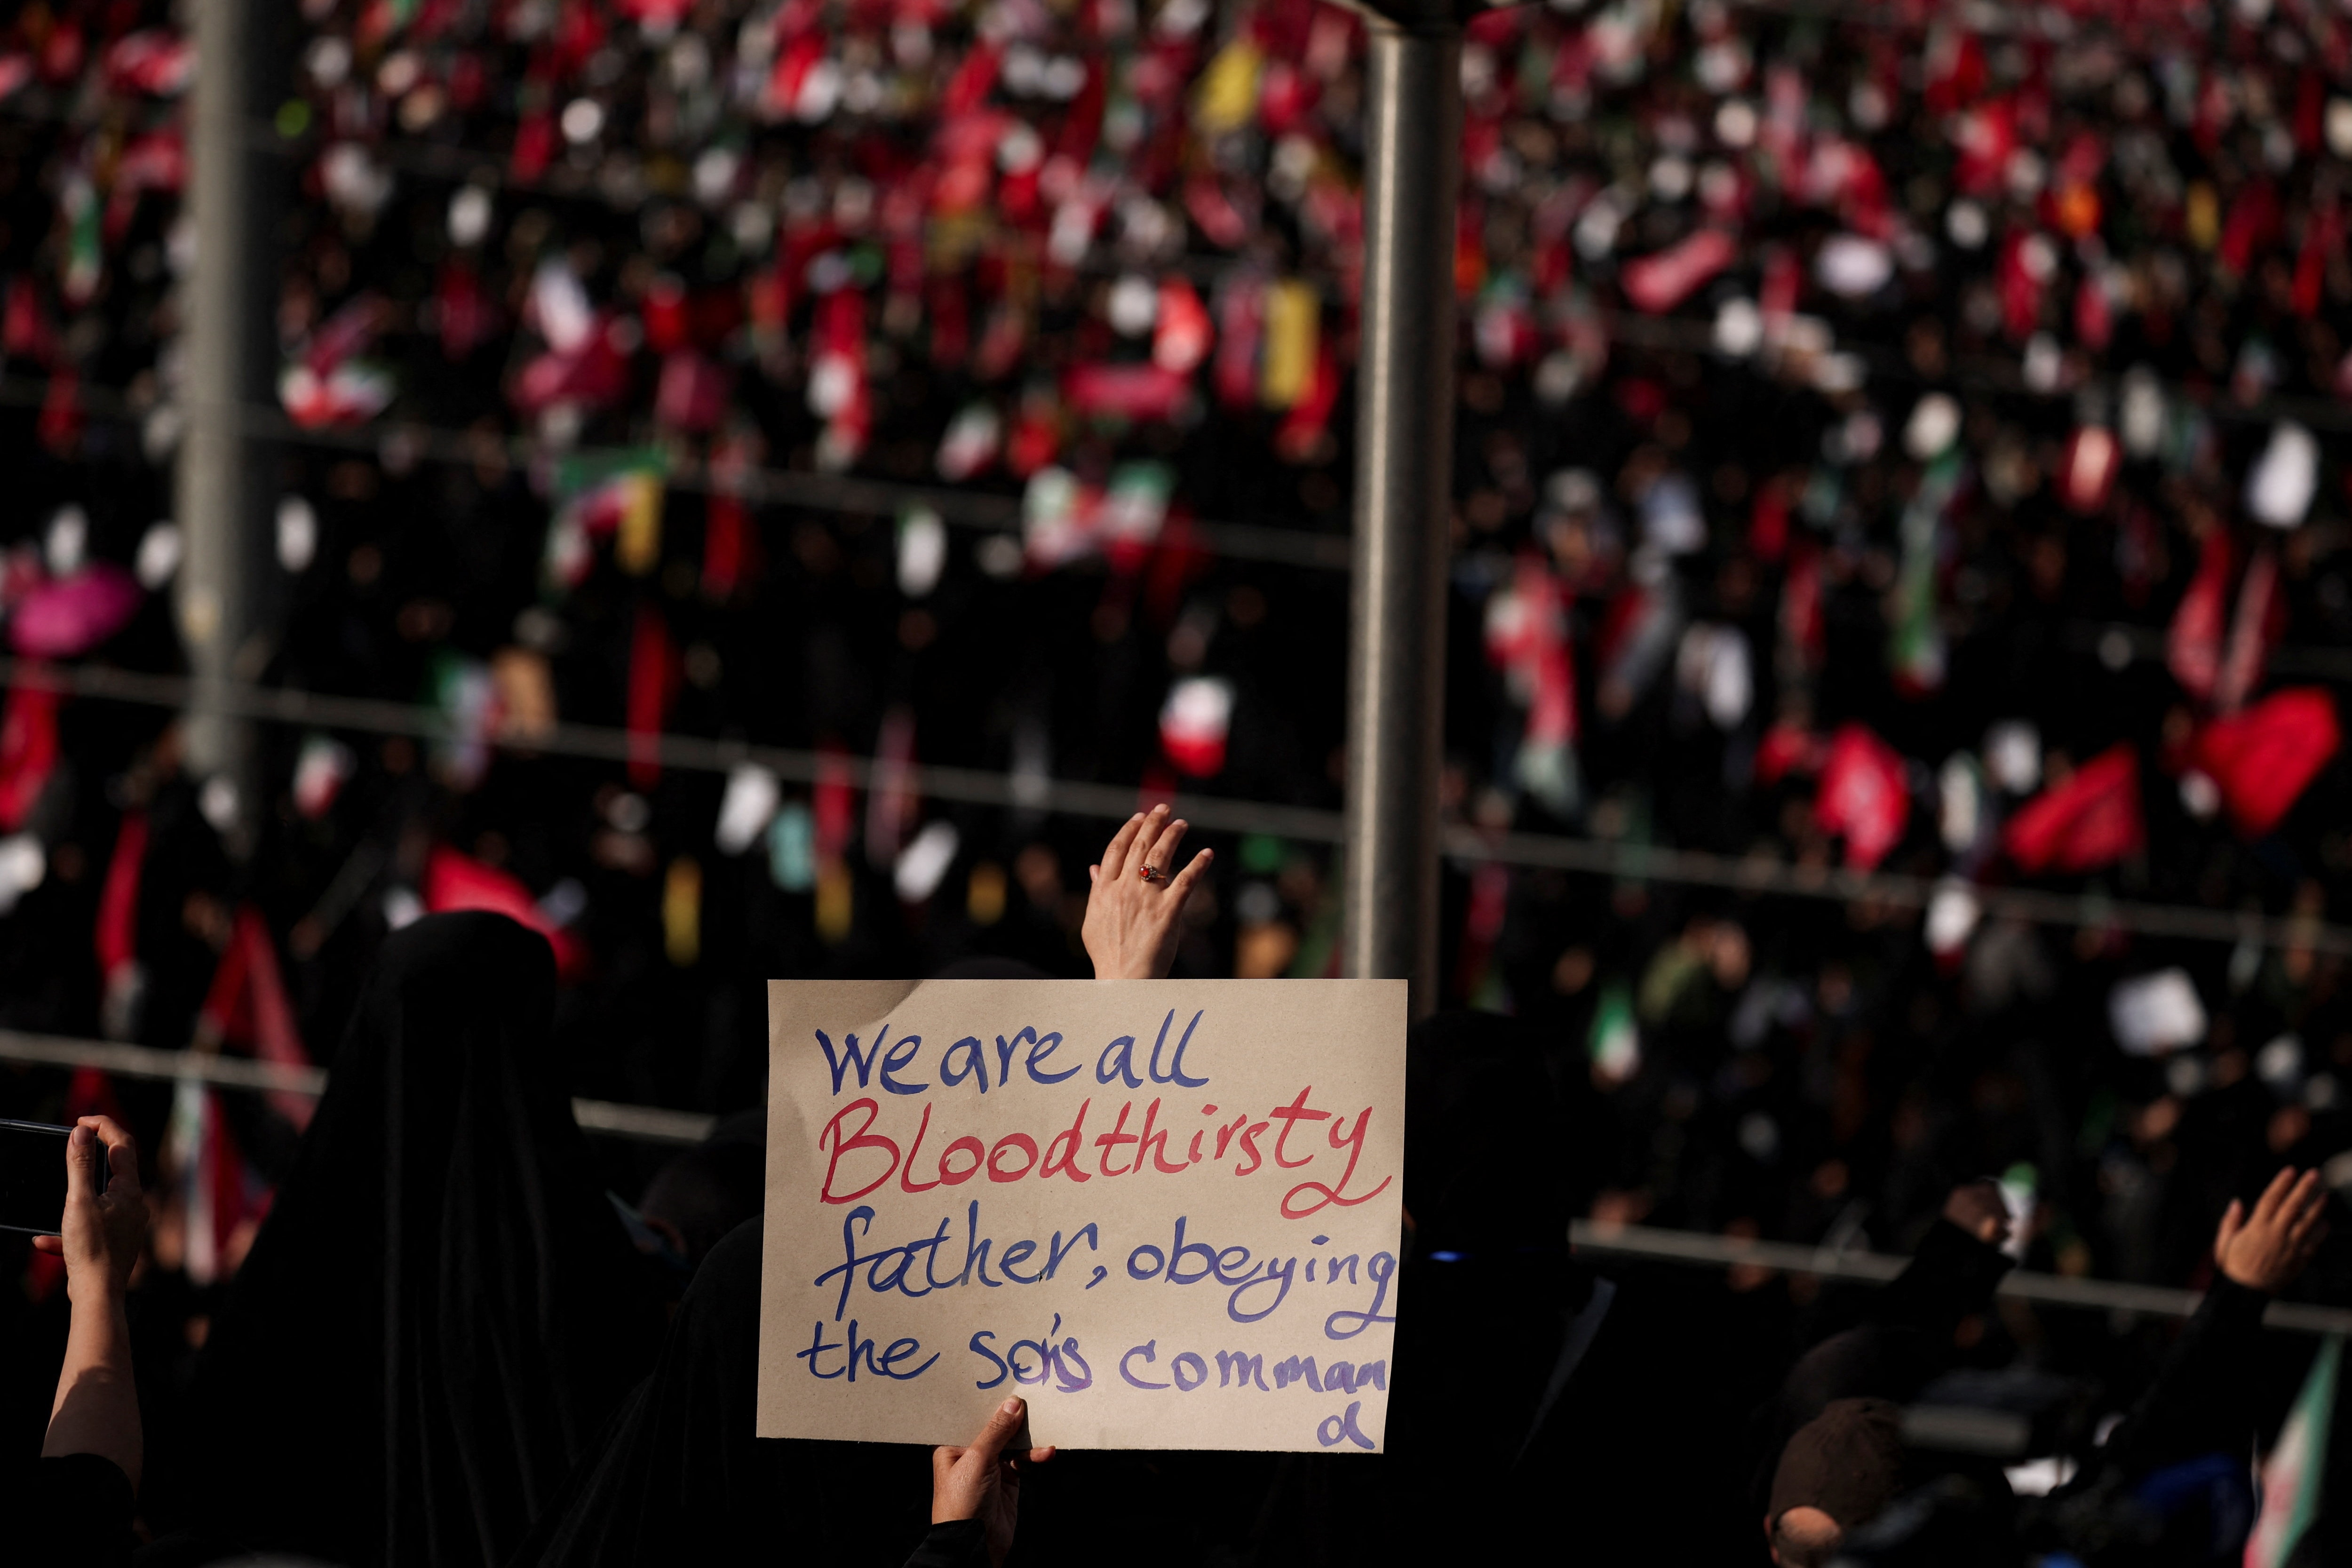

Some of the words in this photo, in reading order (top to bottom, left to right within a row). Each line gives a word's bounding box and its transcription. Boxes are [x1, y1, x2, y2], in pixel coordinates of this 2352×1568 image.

[940, 1026, 1082, 1094] are
[1096, 1008, 1209, 1089] all
[819, 1086, 1392, 1219] Bloodthirsty
[814, 1200, 1108, 1321] father,
[1127, 1216, 1396, 1340] obeying
[796, 1320, 940, 1383] the
